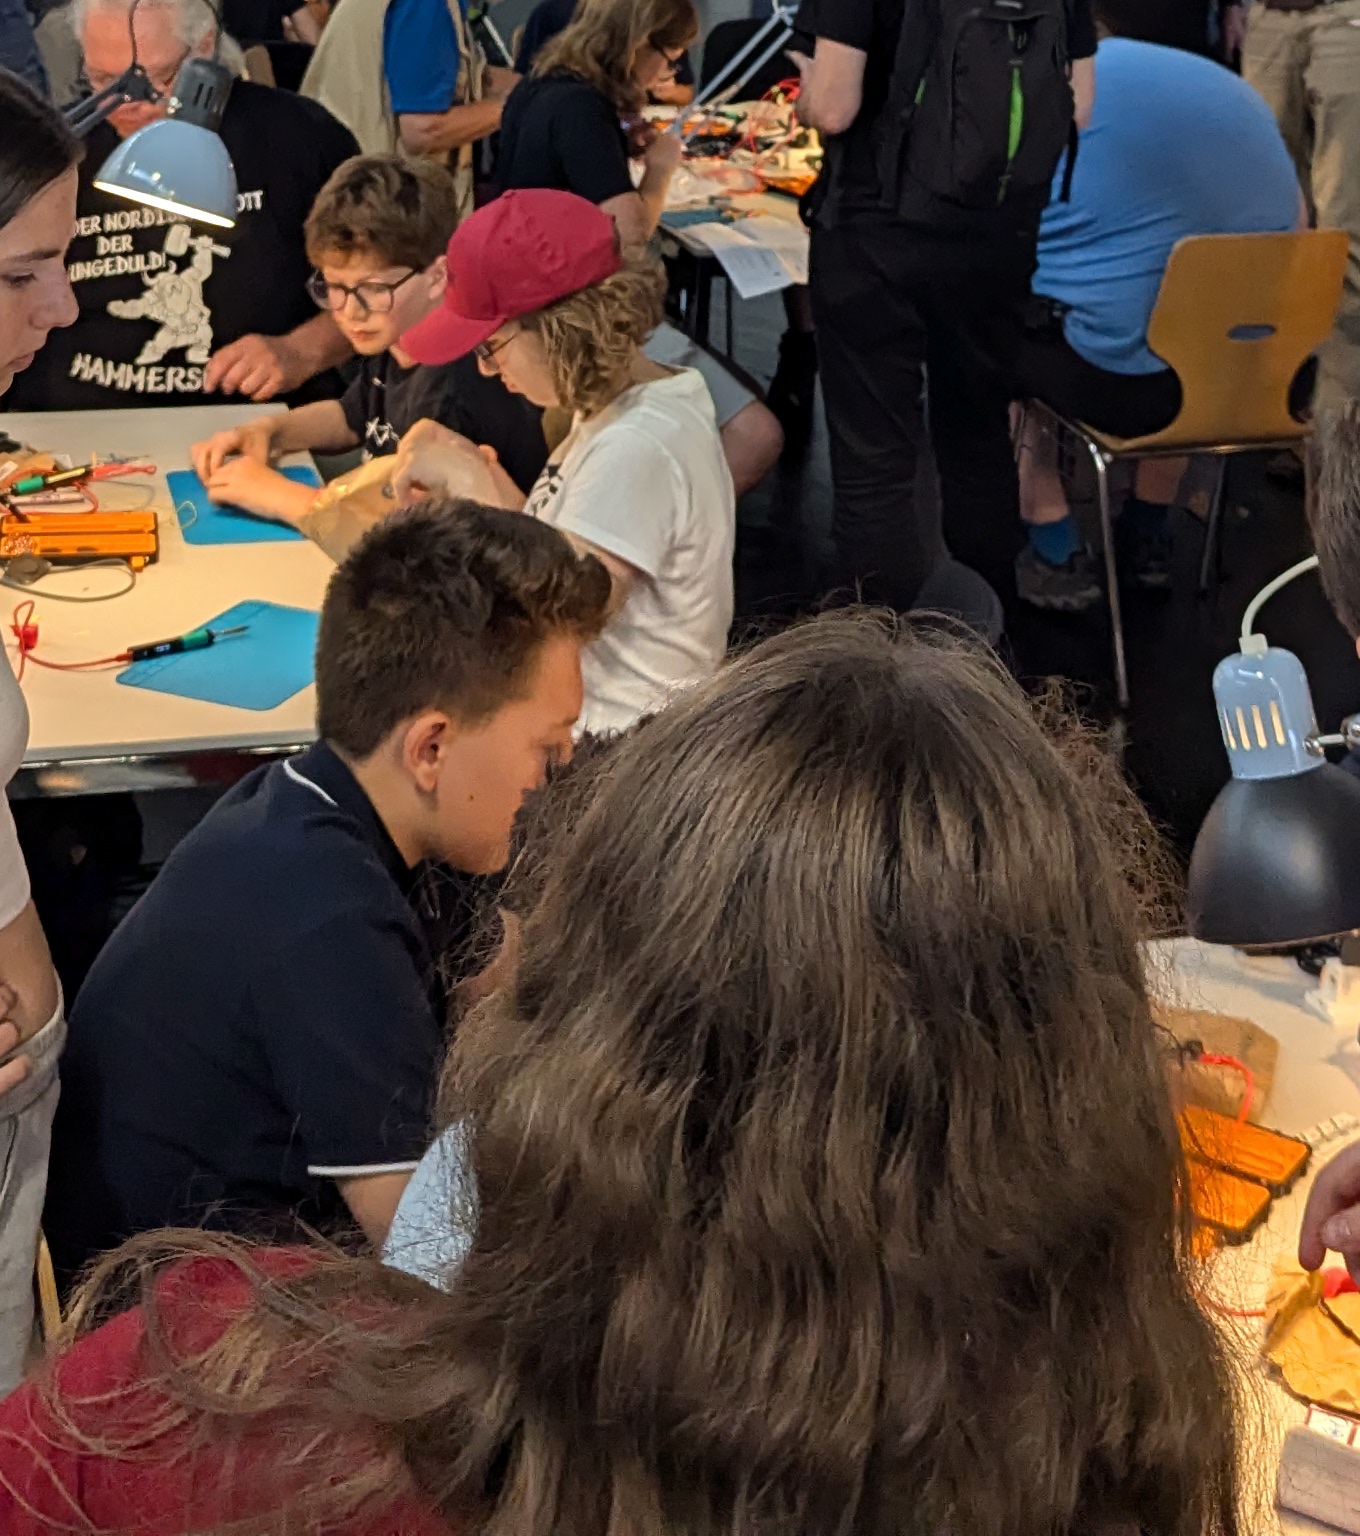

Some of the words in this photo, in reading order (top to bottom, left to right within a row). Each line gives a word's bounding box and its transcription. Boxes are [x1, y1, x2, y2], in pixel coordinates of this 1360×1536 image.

[96, 234, 134, 254] DER
[70, 252, 168, 282] UNGEDULD!
[69, 353, 207, 393] HAMMERS
